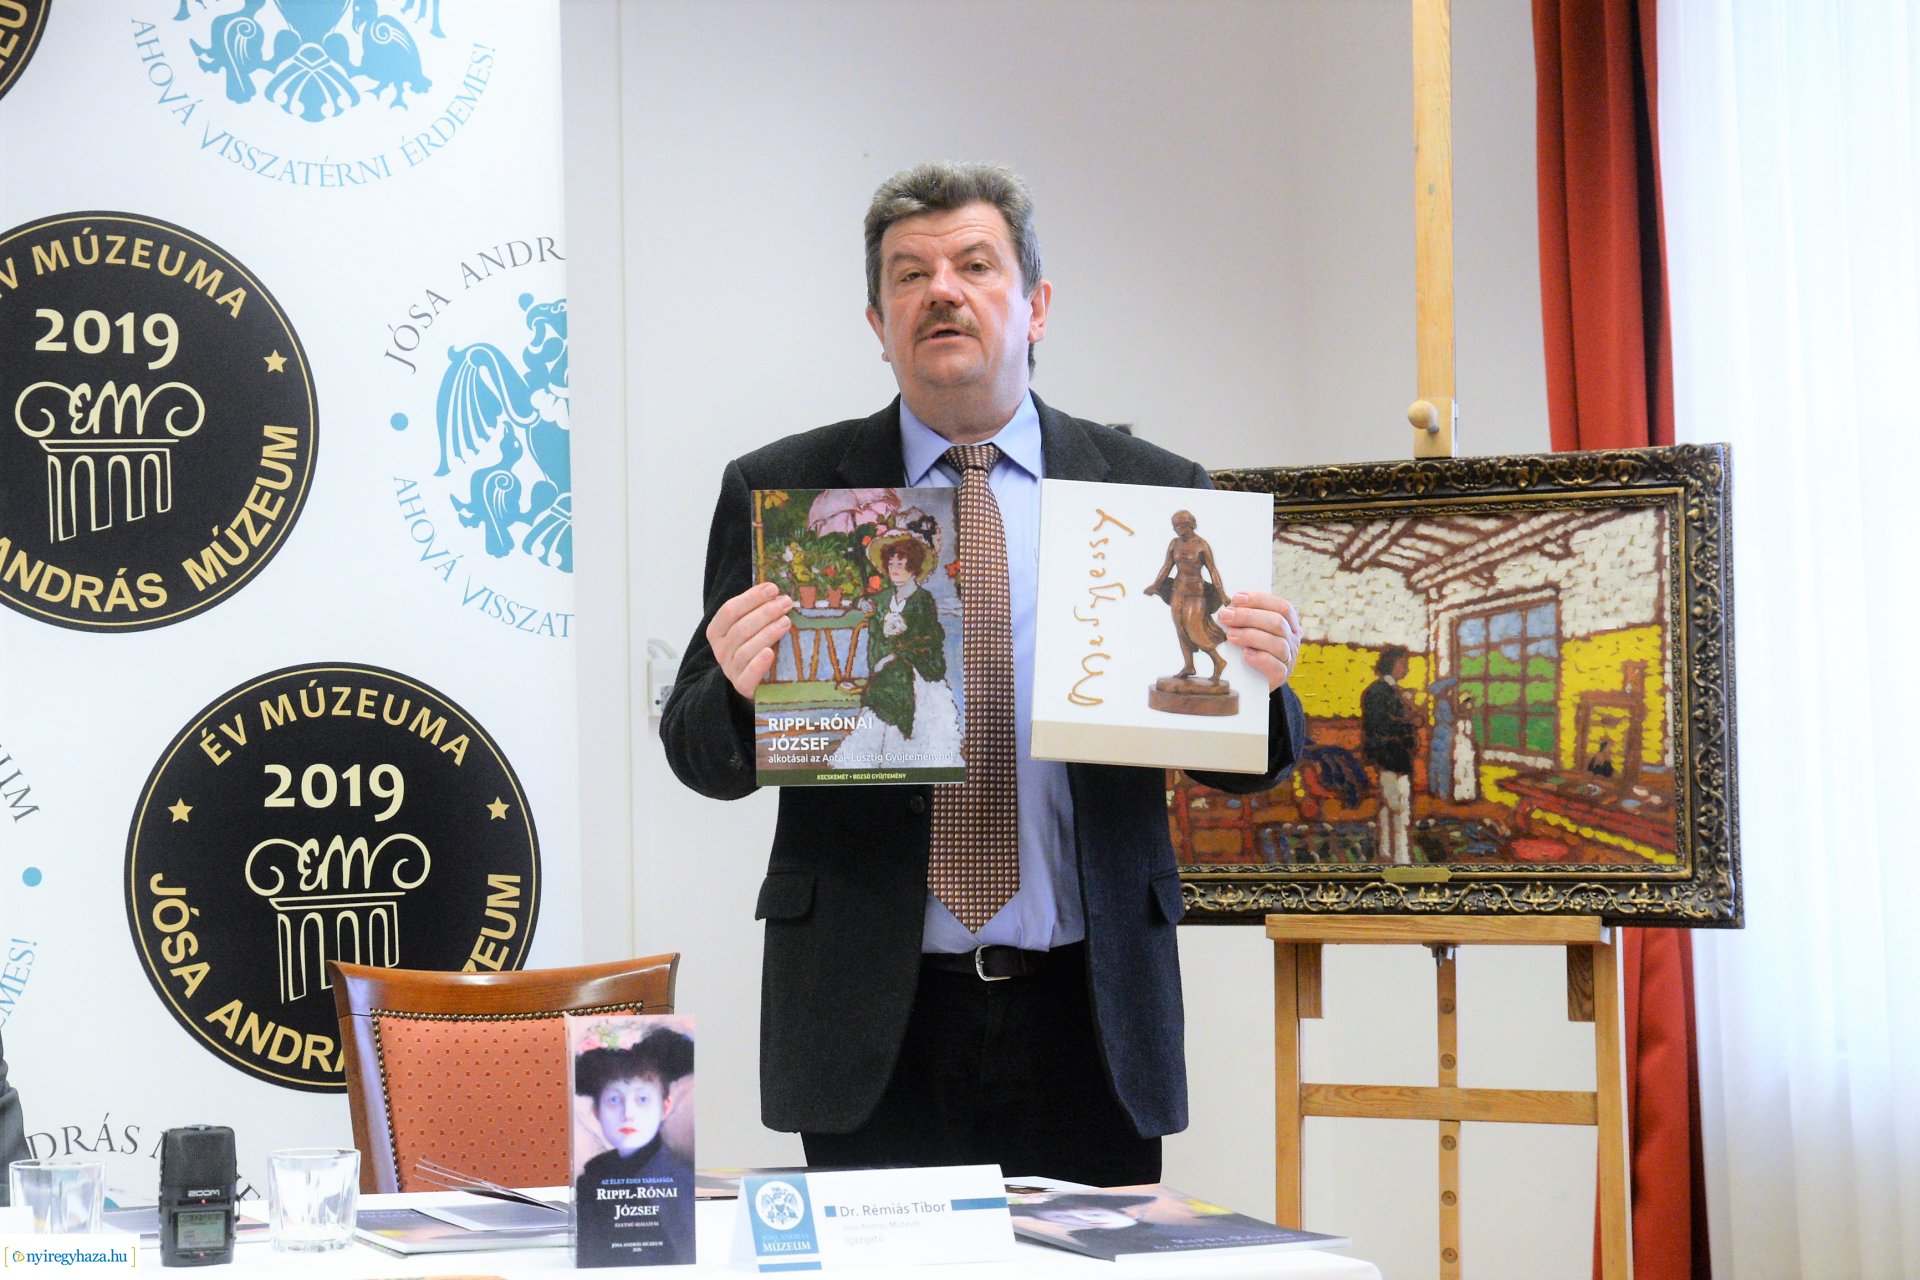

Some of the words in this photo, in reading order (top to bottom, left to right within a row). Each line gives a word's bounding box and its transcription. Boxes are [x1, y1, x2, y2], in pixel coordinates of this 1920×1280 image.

[131, 17, 204, 127] AHOVÁ
[200, 118, 392, 188] VISSZATÉRNI
[400, 42, 496, 168] ÉRDEMES!
[31, 227, 247, 319] MÚZEUMA
[384, 288, 452, 376] JÓSA
[460, 236, 567, 290] ANDR
[35, 308, 180, 370] 2019
[181, 424, 299, 592] MÚZEUM
[393, 476, 465, 583] AHOVÁ
[199, 713, 248, 767] ÉV
[259, 679, 471, 767] MÚZEUMA
[768, 713, 873, 732] RIPPL-RÓNAI
[768, 735, 829, 752] JÓZSEF
[768, 753, 809, 764] alkotásai
[810, 755, 821, 763] az
[263, 763, 405, 823] 2019
[150, 872, 211, 999] JÓSA
[205, 998, 346, 1073] ANDR
[461, 873, 521, 972] EUM
[25, 1111, 141, 1161] DRÁS
[188, 1189, 220, 1197] ZOOM
[596, 1186, 679, 1201] RIPPL-RÓNAI
[613, 1203, 660, 1220] JÓZSEF
[840, 1205, 859, 1217] Dr.
[863, 1202, 911, 1217] Rémiás
[911, 1201, 947, 1214] Tibor
[763, 1240, 812, 1252] MÚZEUM
